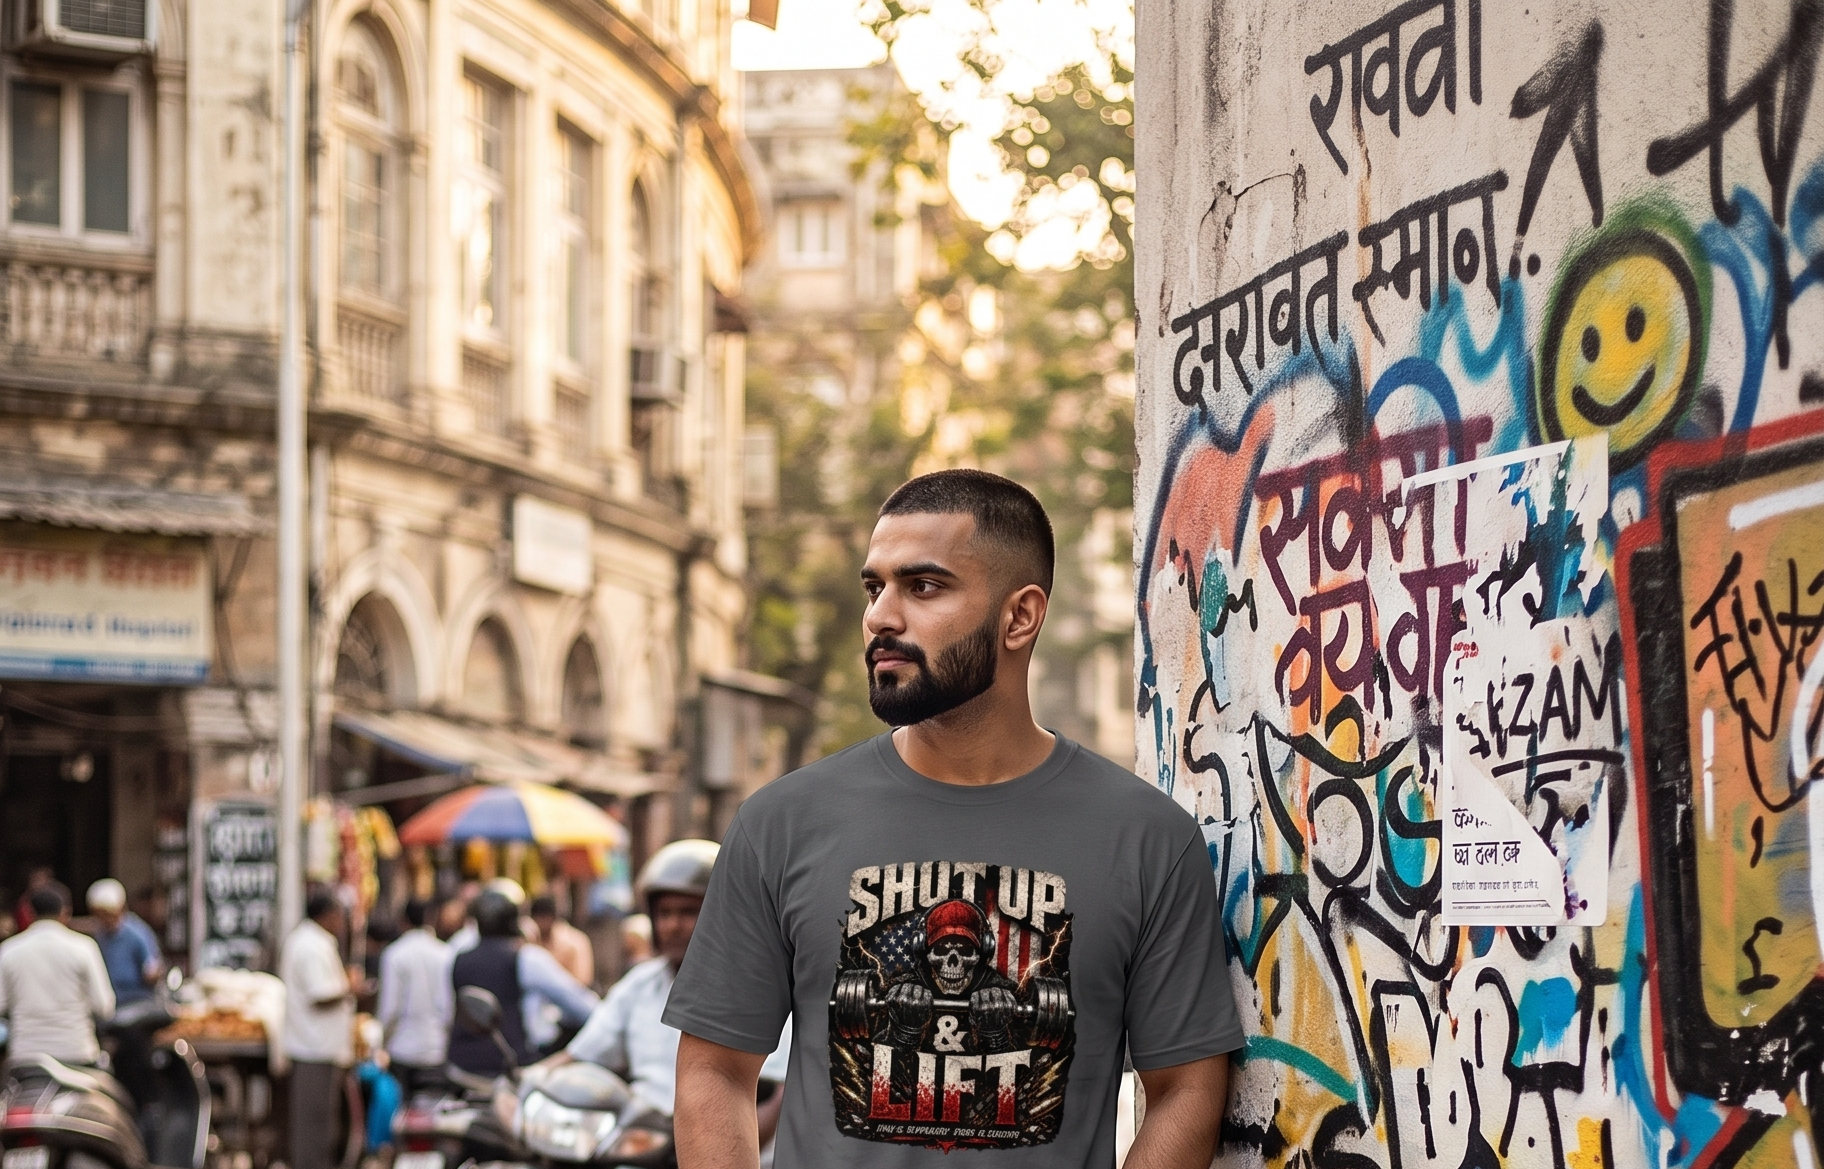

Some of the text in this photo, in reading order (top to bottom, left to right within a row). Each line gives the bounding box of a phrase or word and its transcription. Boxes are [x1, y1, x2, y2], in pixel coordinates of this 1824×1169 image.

[847, 860, 1067, 938] SHUT UP
[933, 1014, 968, 1052] &
[868, 1042, 1033, 1126] LIFT
